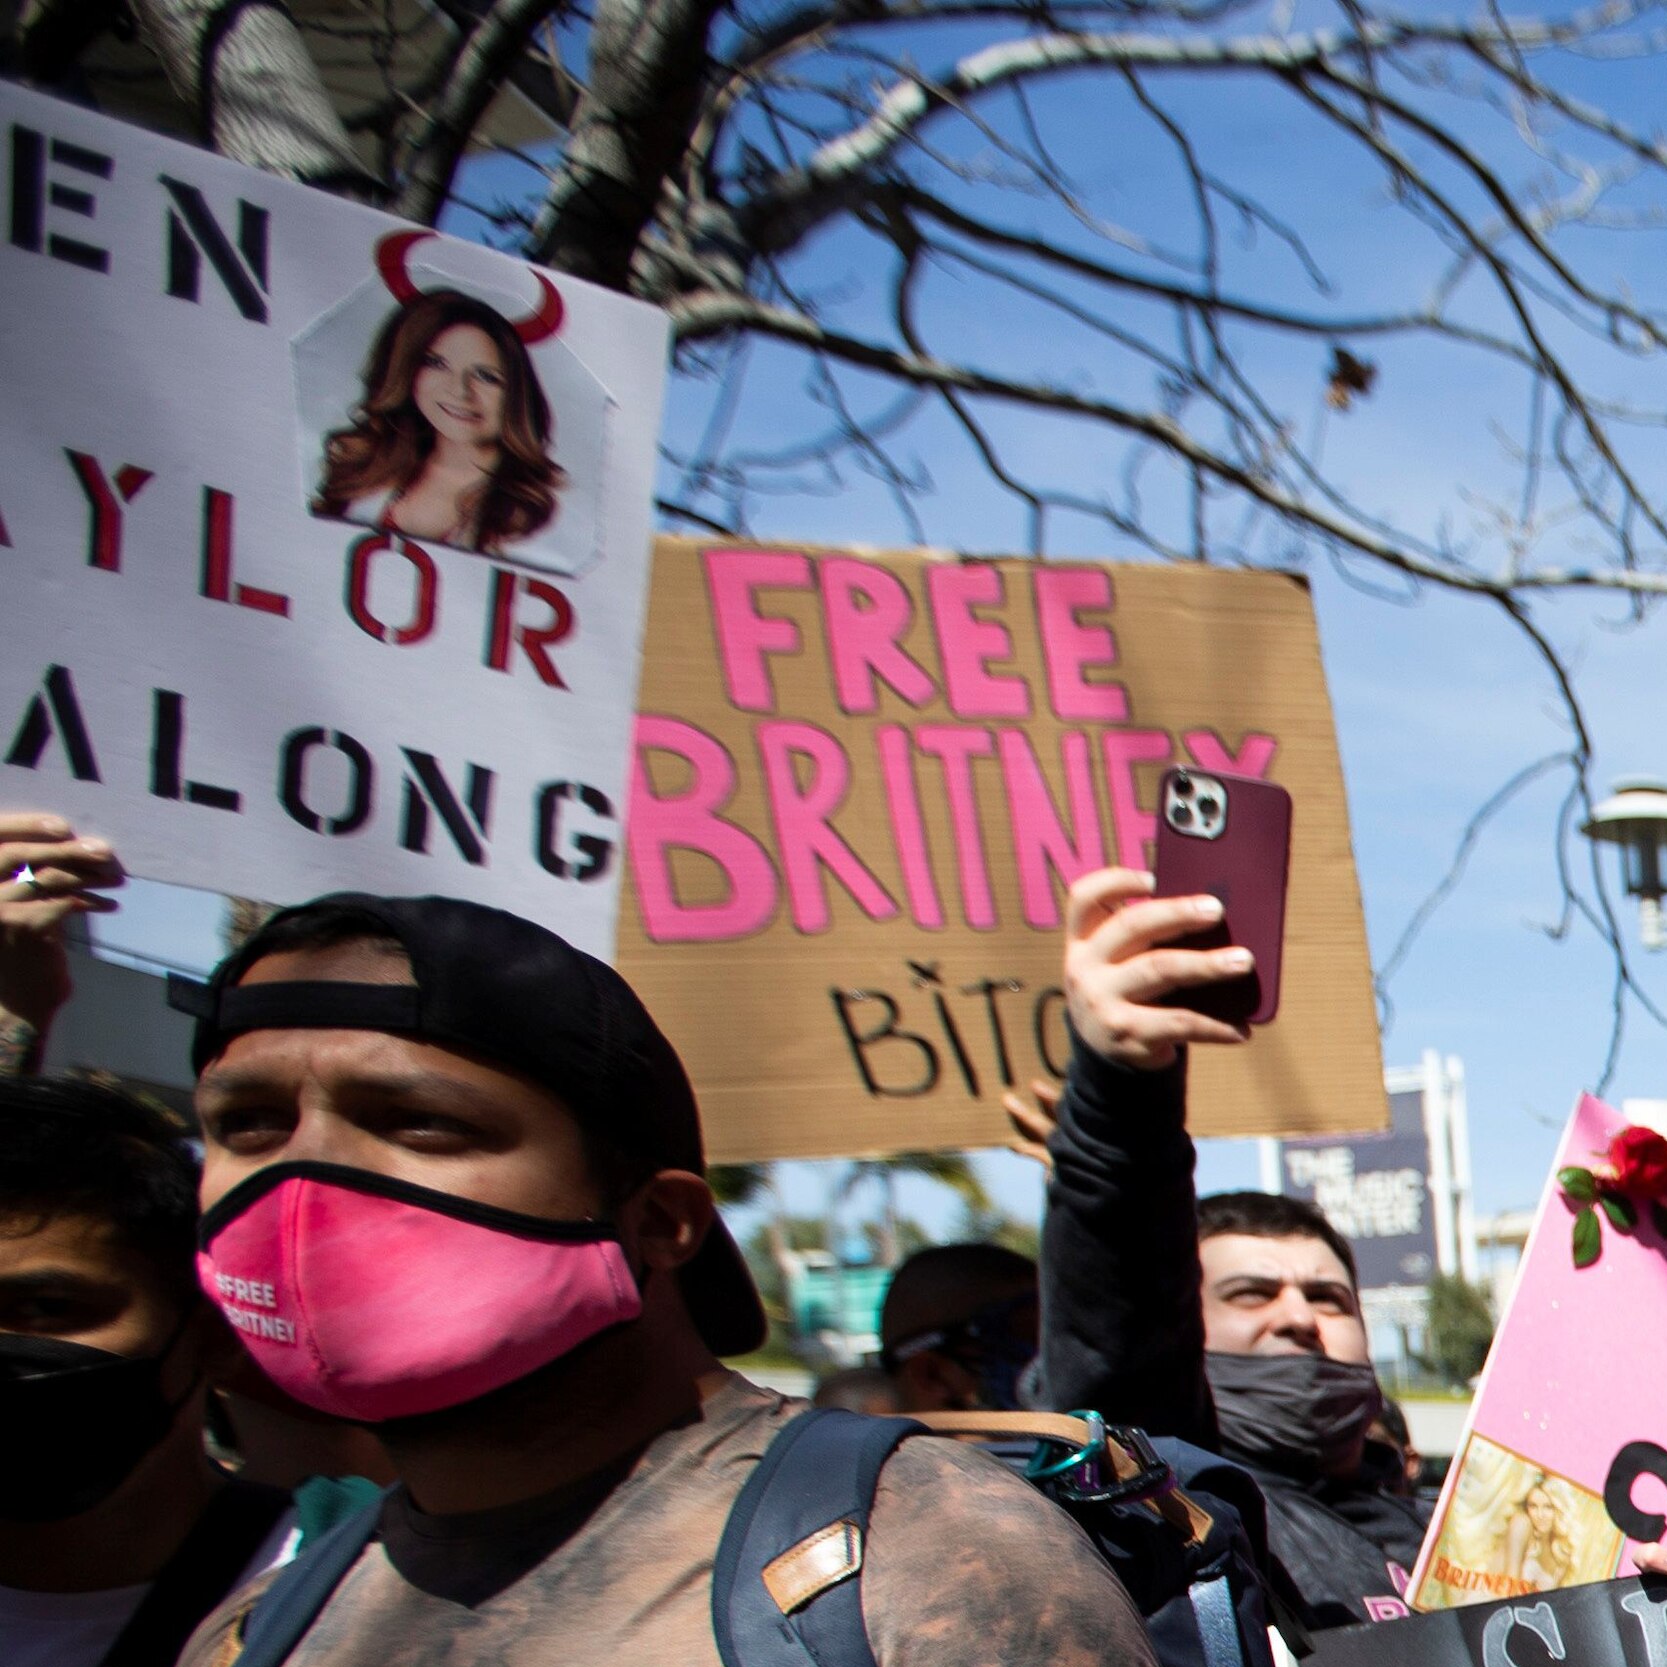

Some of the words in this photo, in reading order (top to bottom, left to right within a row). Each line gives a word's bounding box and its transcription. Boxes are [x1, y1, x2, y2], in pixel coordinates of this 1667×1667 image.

[8, 120, 272, 326] EN
[0, 446, 577, 692] YLOR
[704, 548, 1130, 722] FREE
[4, 662, 620, 882] ALONG
[624, 712, 1278, 942] BRITNE
